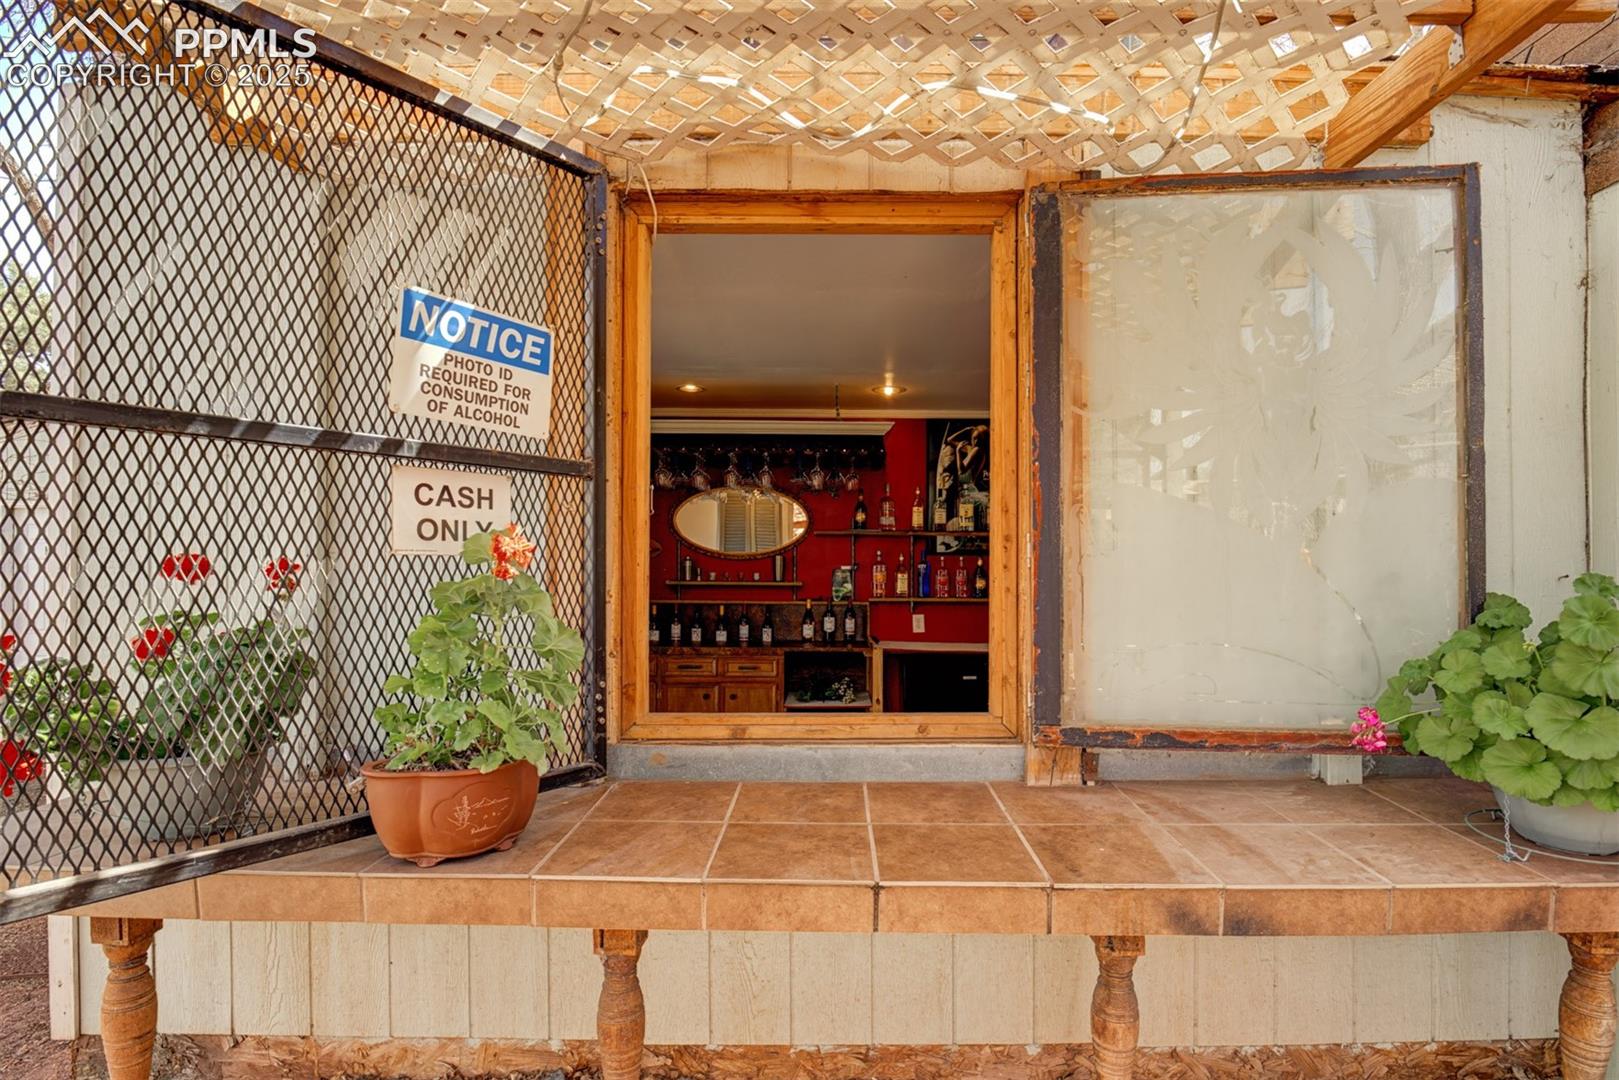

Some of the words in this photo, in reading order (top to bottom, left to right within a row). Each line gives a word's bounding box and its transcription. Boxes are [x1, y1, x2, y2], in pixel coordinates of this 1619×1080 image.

[408, 300, 545, 366] NOTICE
[419, 363, 498, 393] REQUIRED
[504, 384, 531, 400] FOR
[443, 353, 493, 376] PHOTO
[499, 367, 513, 381] ID
[420, 381, 529, 415] CONSUMPTION
[427, 399, 449, 414] OF
[453, 405, 521, 429] ALCOHOL
[414, 482, 494, 510] CASH
